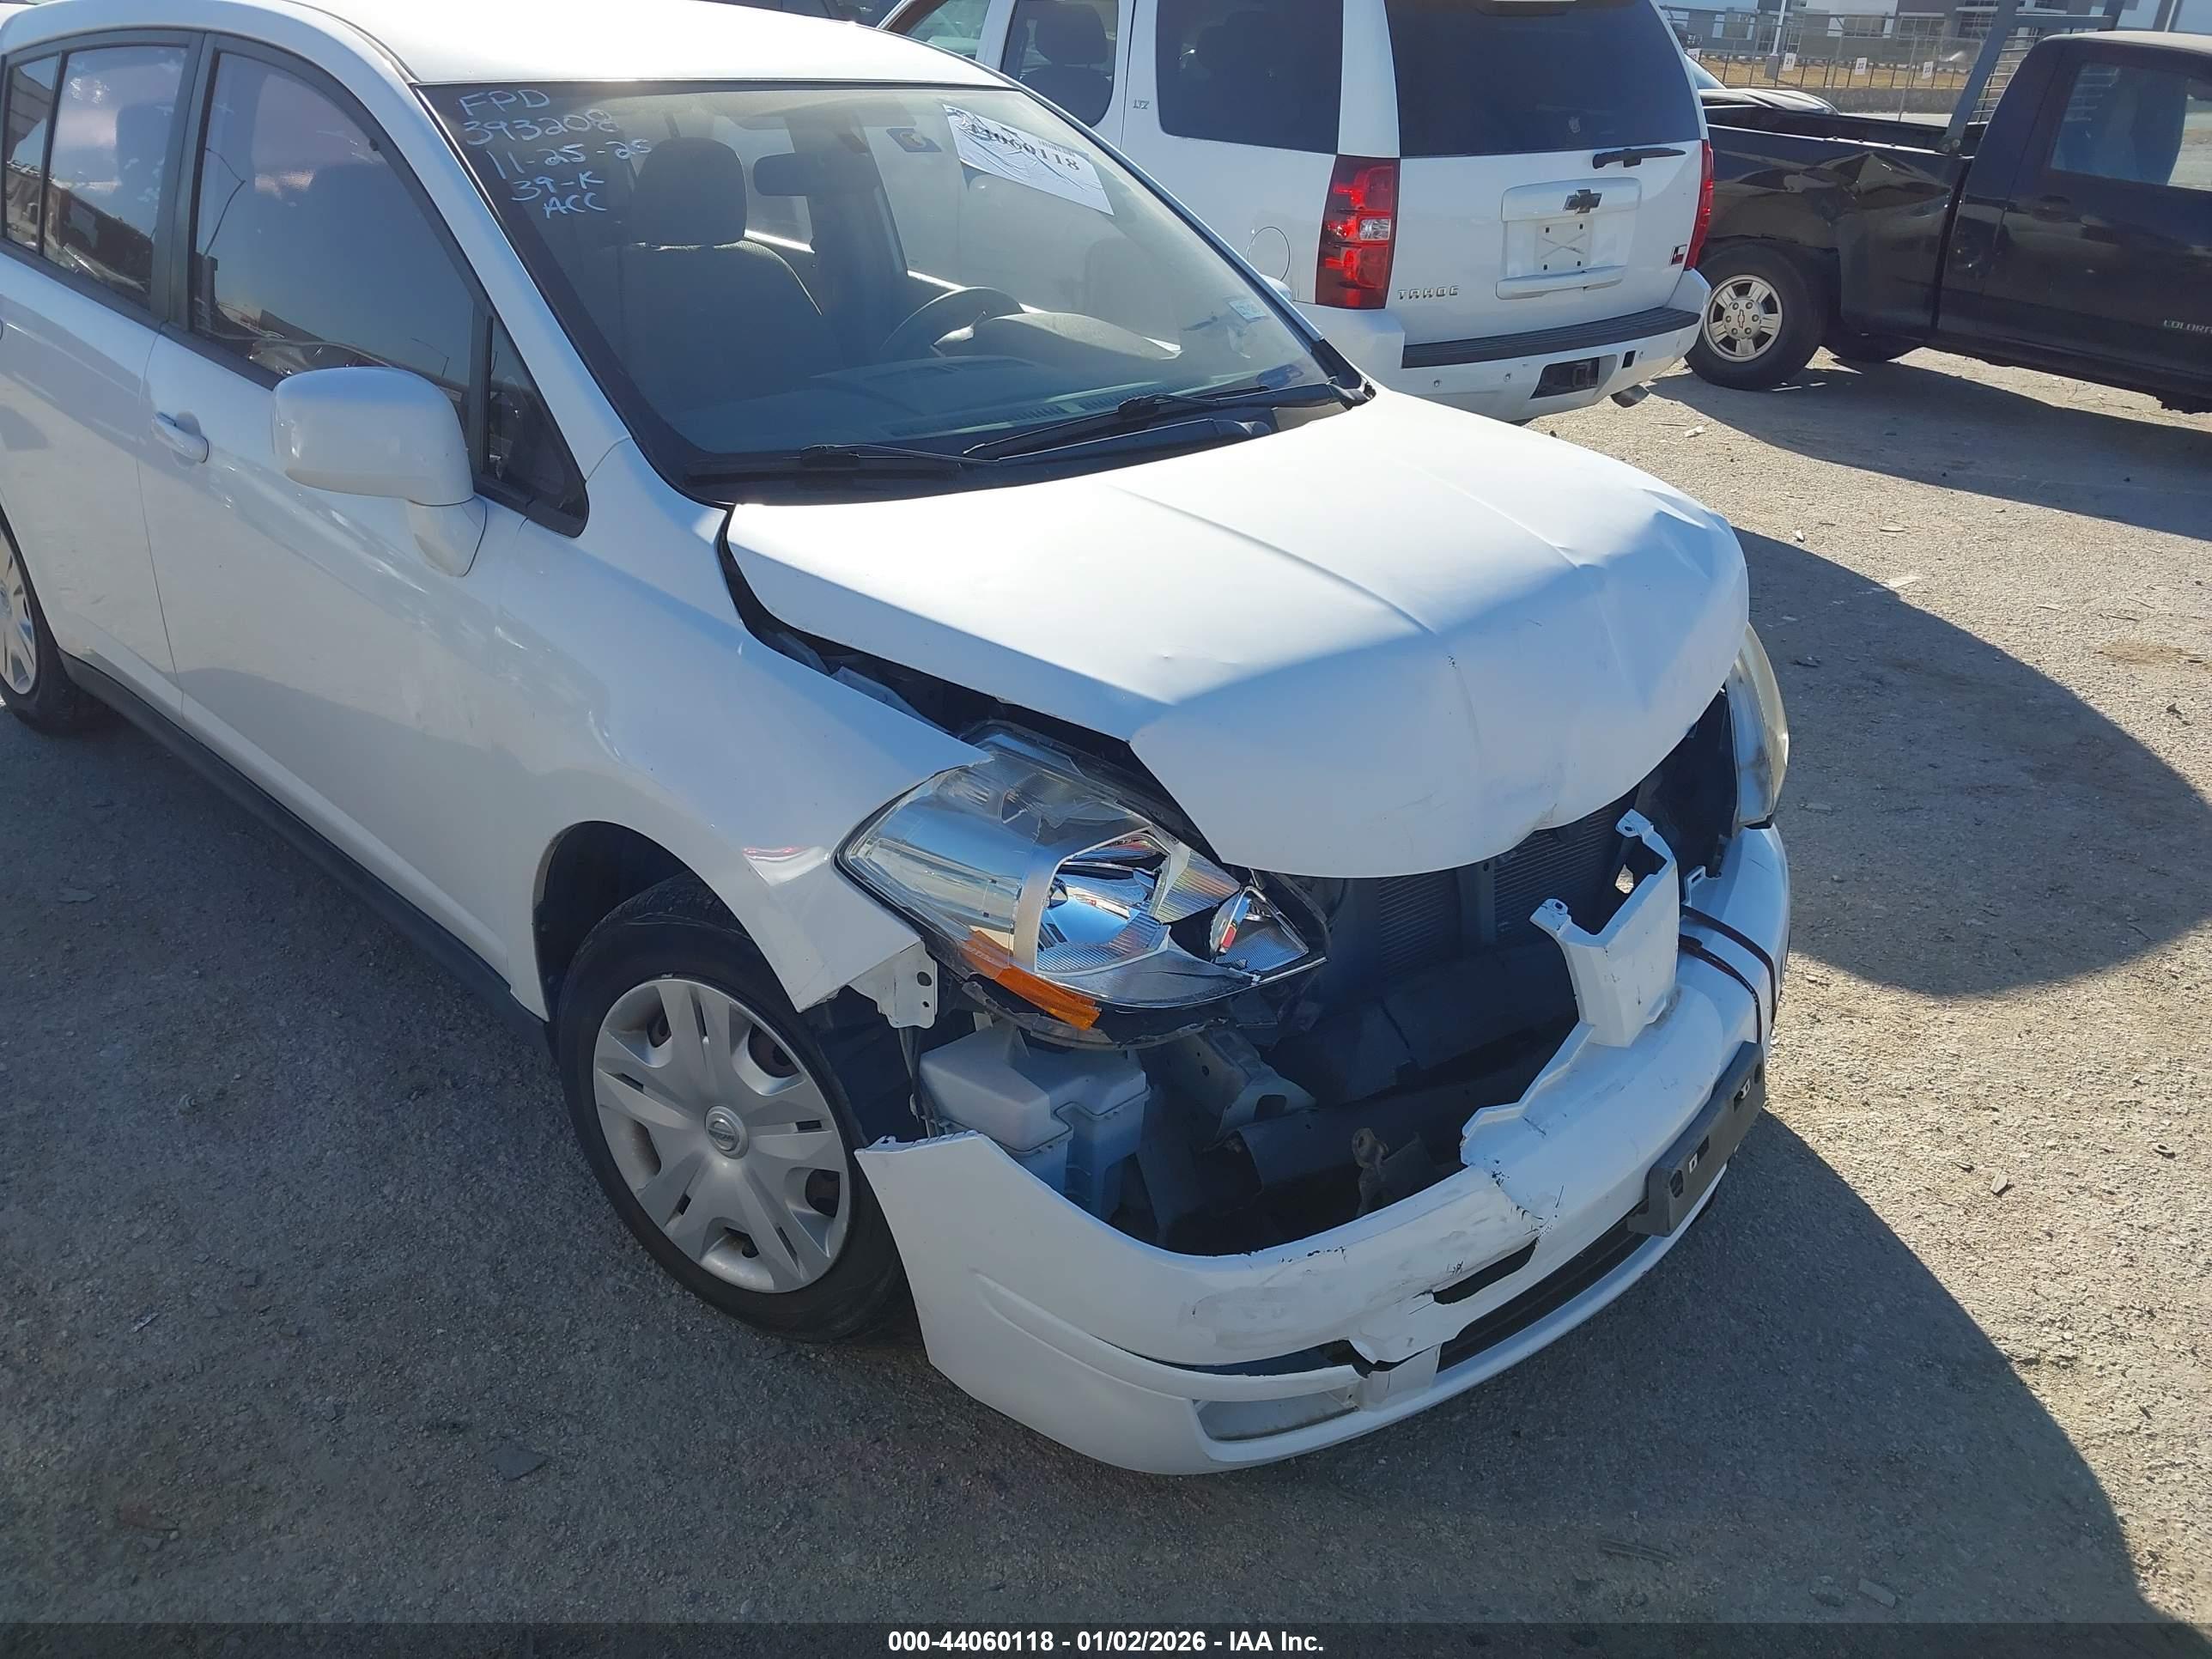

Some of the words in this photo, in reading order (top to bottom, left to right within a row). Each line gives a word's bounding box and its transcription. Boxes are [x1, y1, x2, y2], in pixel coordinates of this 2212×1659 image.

[459, 89, 550, 116] FPD
[1133, 99, 1150, 110] LTZ
[464, 109, 618, 145] 393208
[512, 171, 605, 201] 39-K
[543, 192, 608, 219] ACC
[1397, 285, 1459, 301] TAHOE
